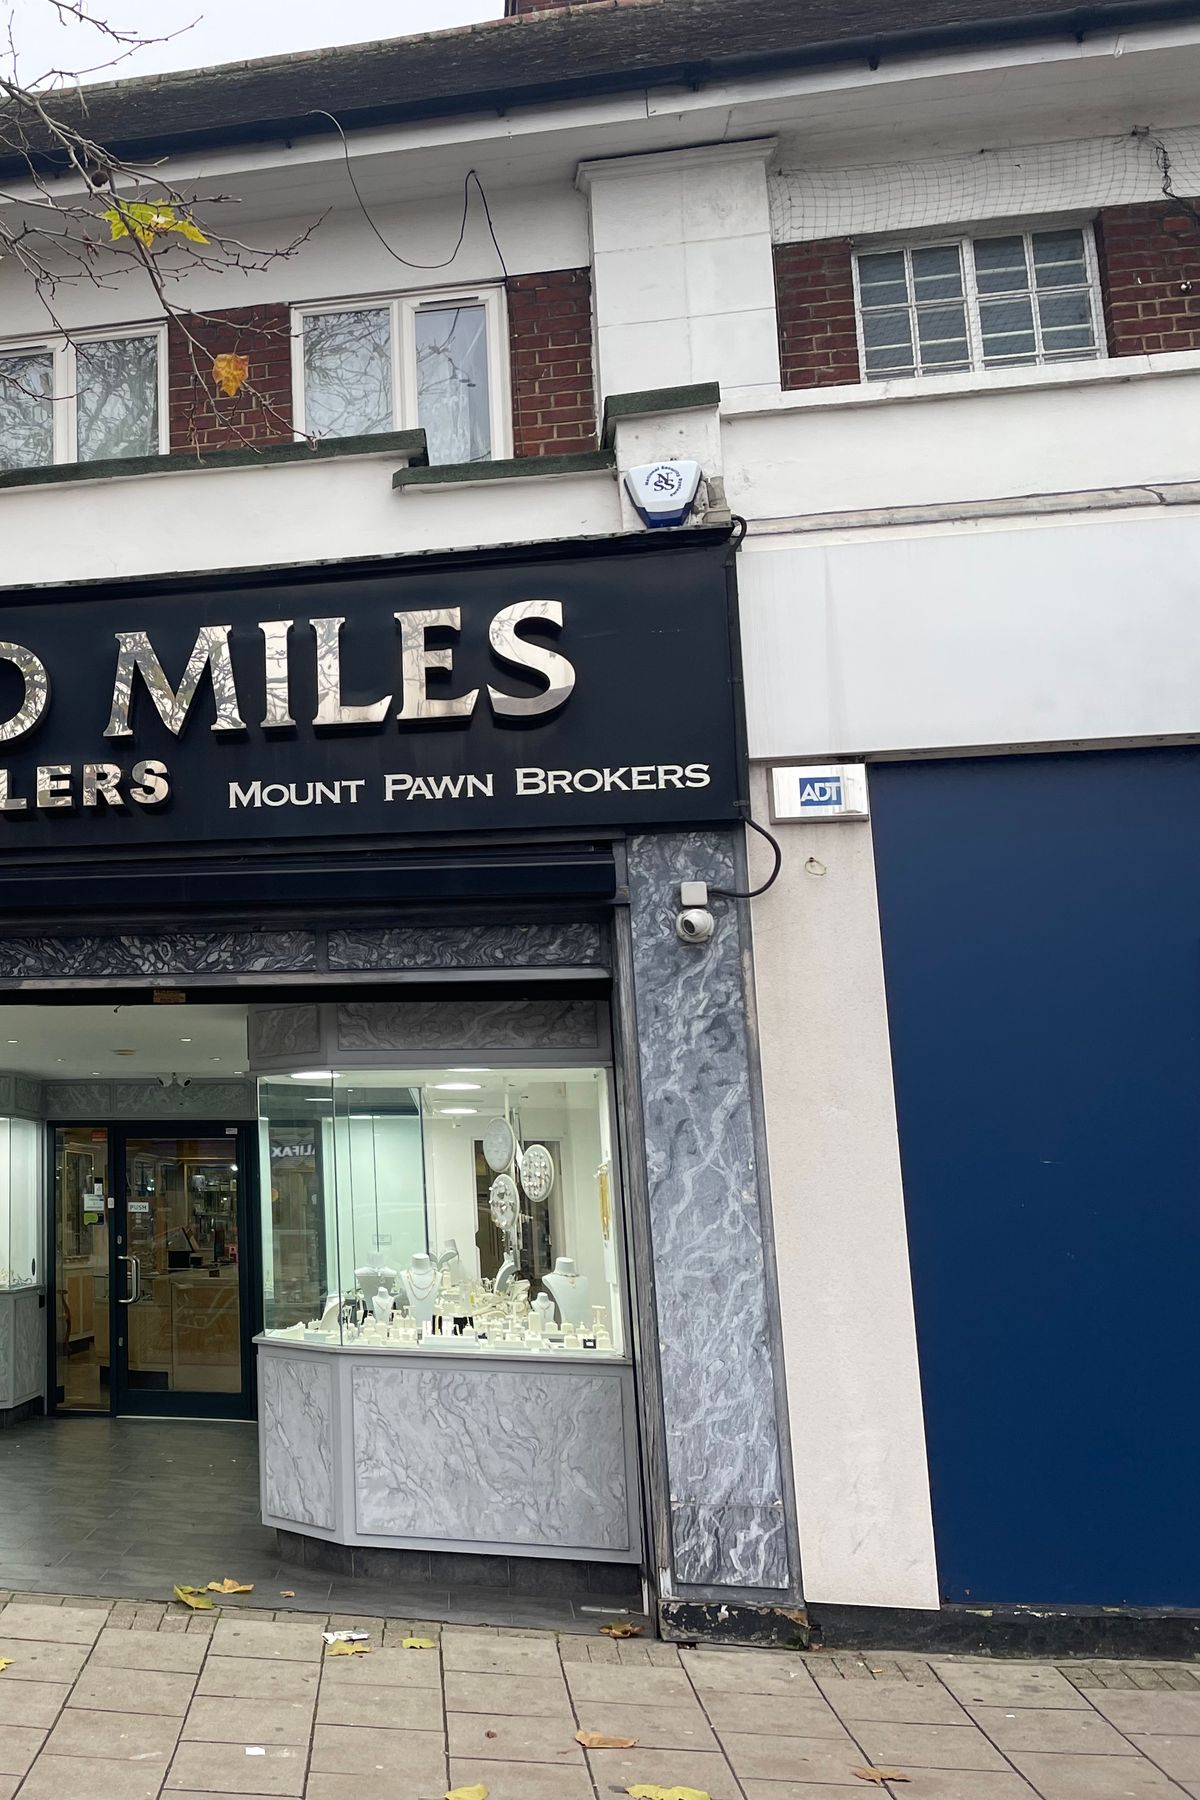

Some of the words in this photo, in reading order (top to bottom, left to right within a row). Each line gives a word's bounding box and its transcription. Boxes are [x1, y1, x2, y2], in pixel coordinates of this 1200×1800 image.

[103, 600, 577, 738] MILES
[229, 779, 365, 809] MOUNT
[384, 773, 494, 801] PAWN
[516, 763, 711, 795] BROKERS
[800, 782, 841, 802] ADT
